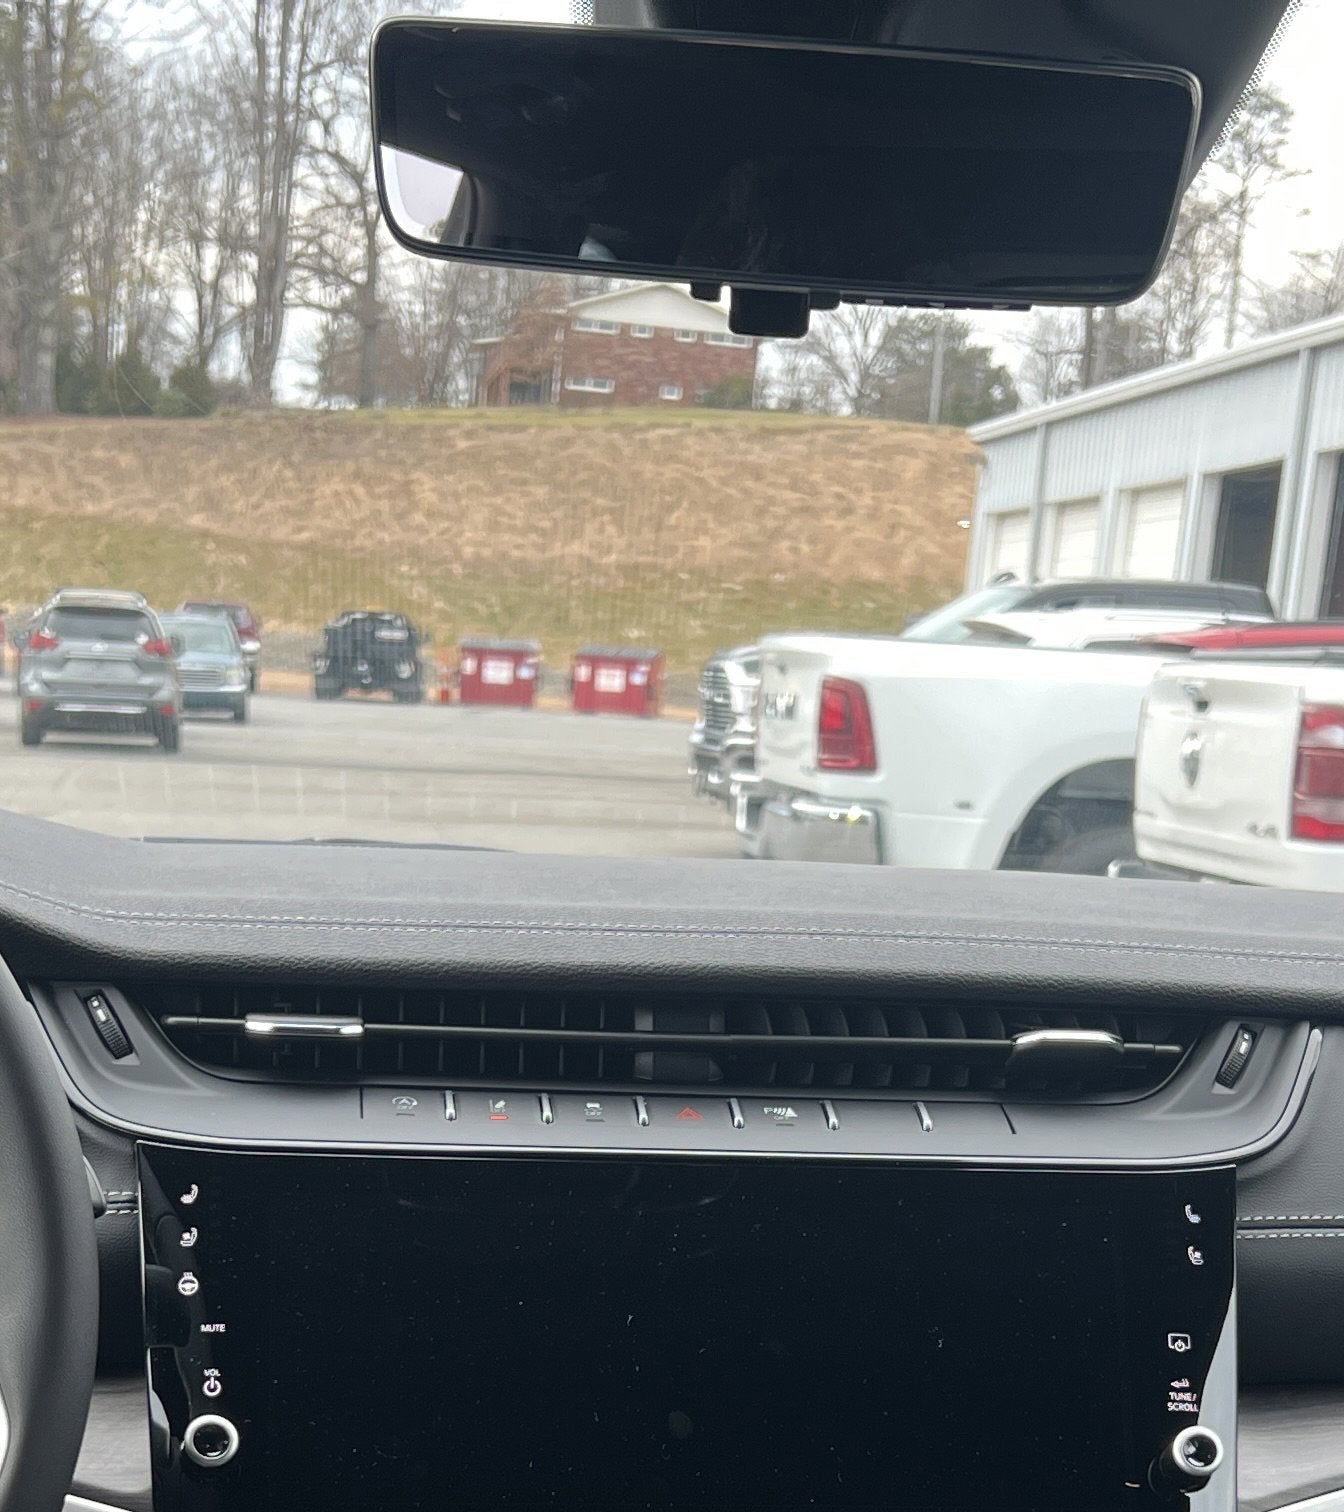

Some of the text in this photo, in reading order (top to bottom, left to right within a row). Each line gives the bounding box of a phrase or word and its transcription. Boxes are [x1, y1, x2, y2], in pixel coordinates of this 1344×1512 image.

[199, 1323, 227, 1333] MUTE
[203, 1368, 222, 1377] VOL
[1168, 1391, 1197, 1402] TUNE/
[1167, 1402, 1199, 1412] SCROLL
